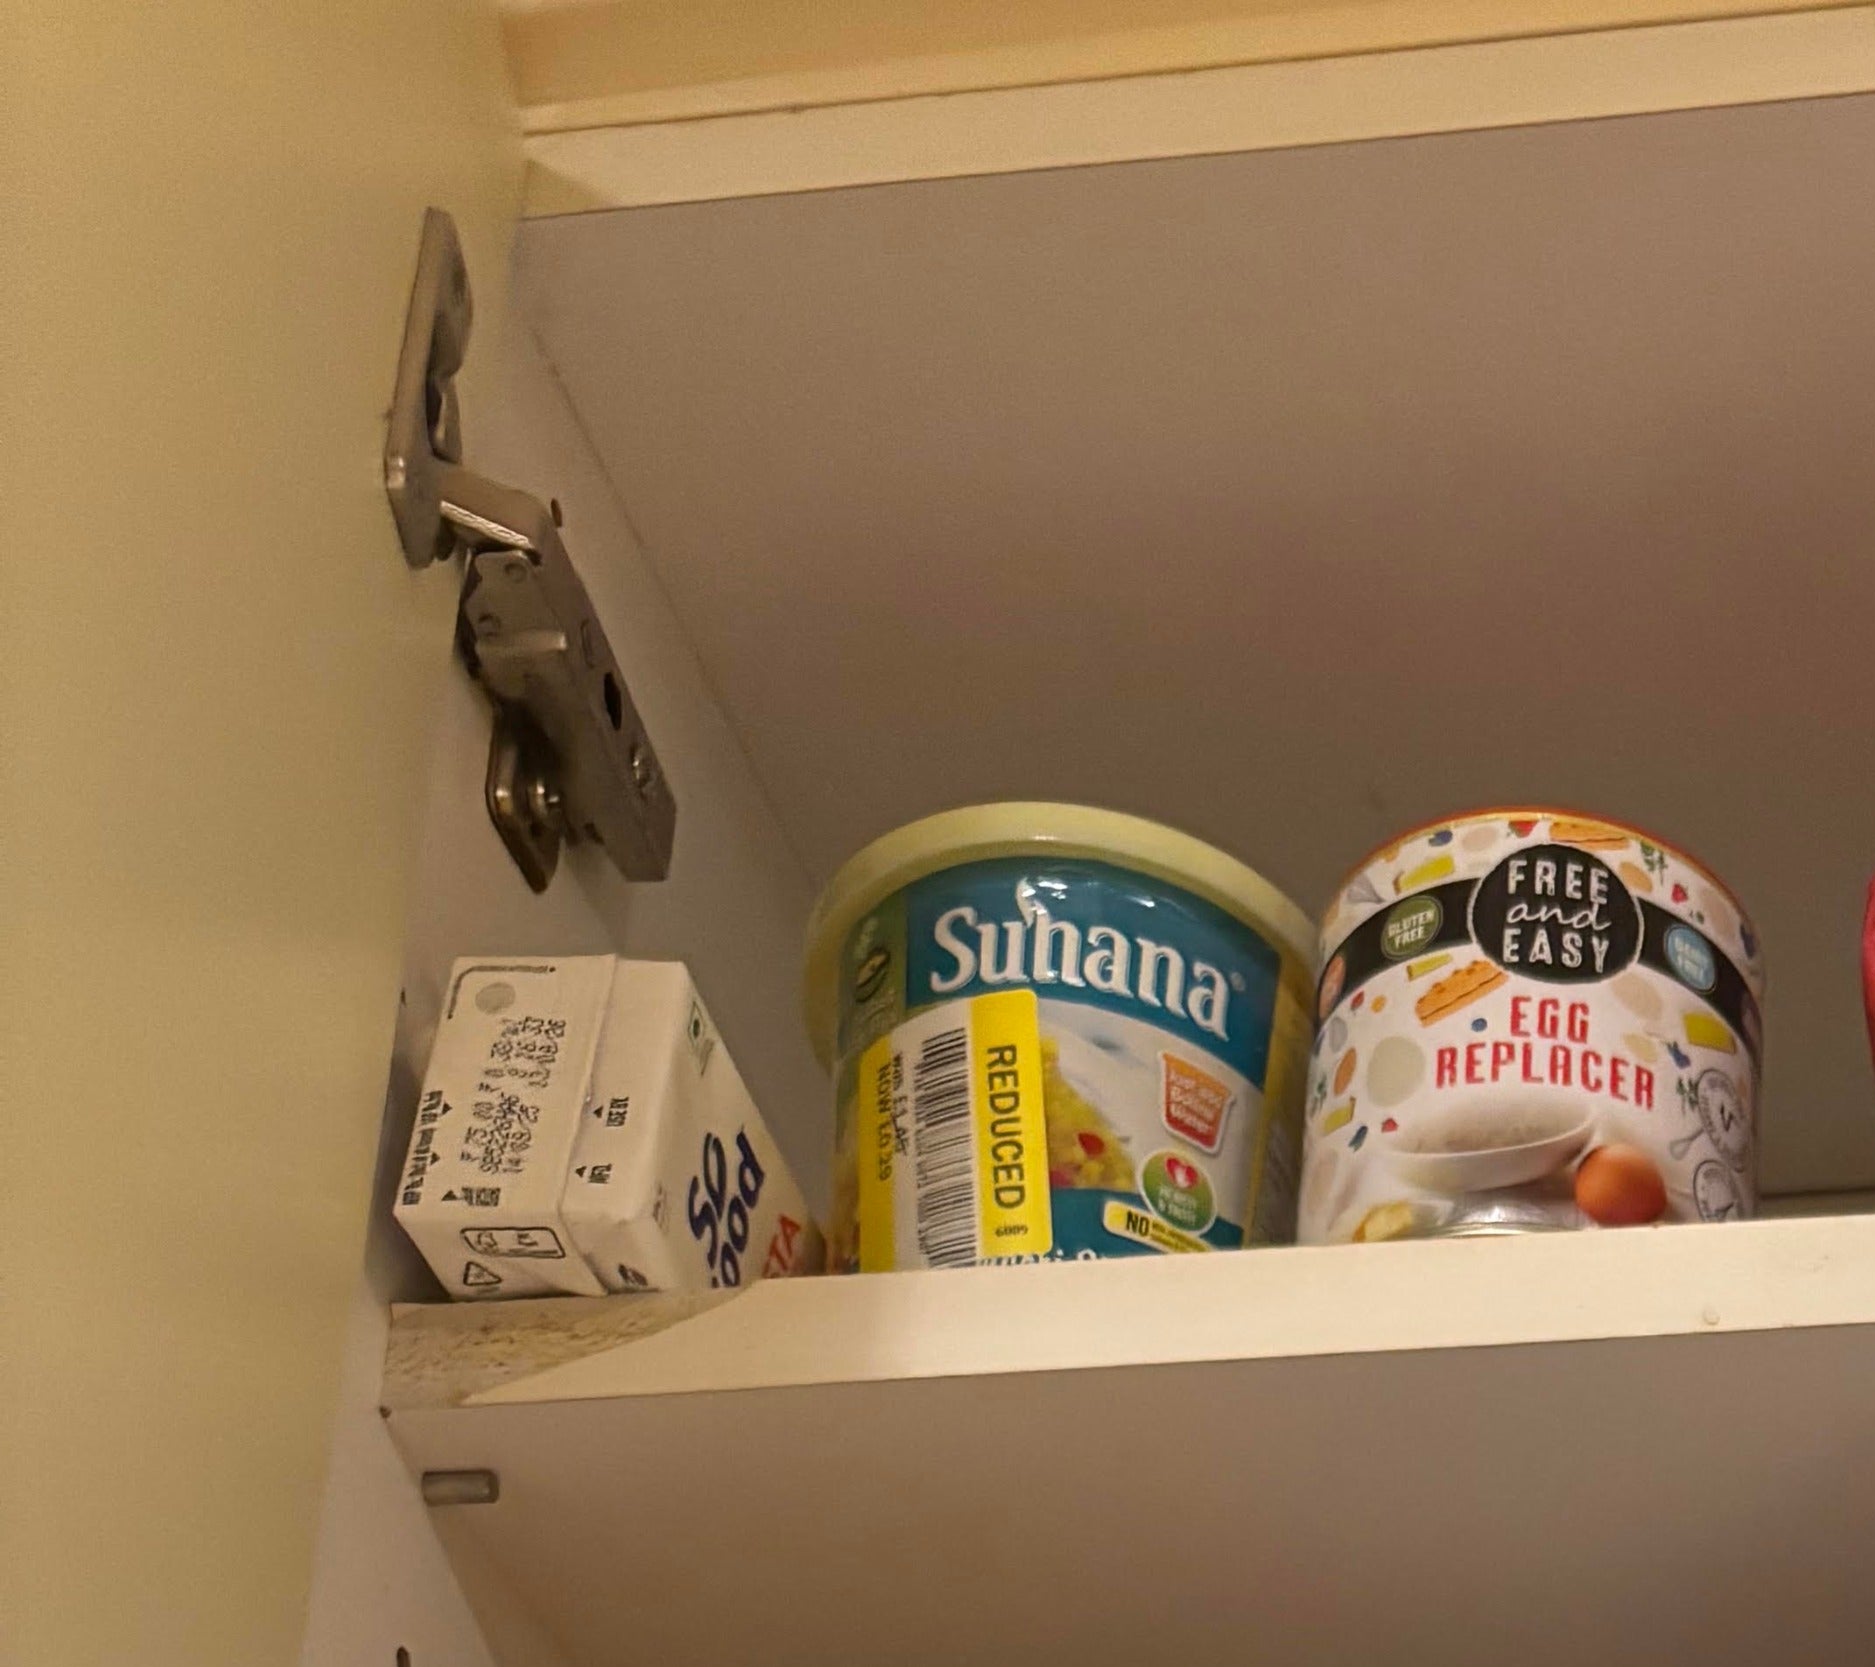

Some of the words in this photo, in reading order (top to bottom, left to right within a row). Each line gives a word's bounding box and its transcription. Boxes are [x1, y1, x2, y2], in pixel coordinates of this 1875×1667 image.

[1507, 859, 1609, 904] FREE
[1388, 910, 1436, 938] GLUTEN
[1395, 926, 1425, 947] FREE
[1505, 902, 1612, 931] and
[930, 878, 1230, 1041] Suhana
[1503, 928, 1610, 973] EASY
[1510, 996, 1591, 1042] EGG
[1436, 1042, 1655, 1109] REPLACER
[986, 1044, 1026, 1209] REDUCED
[1125, 1210, 1150, 1237] NO
